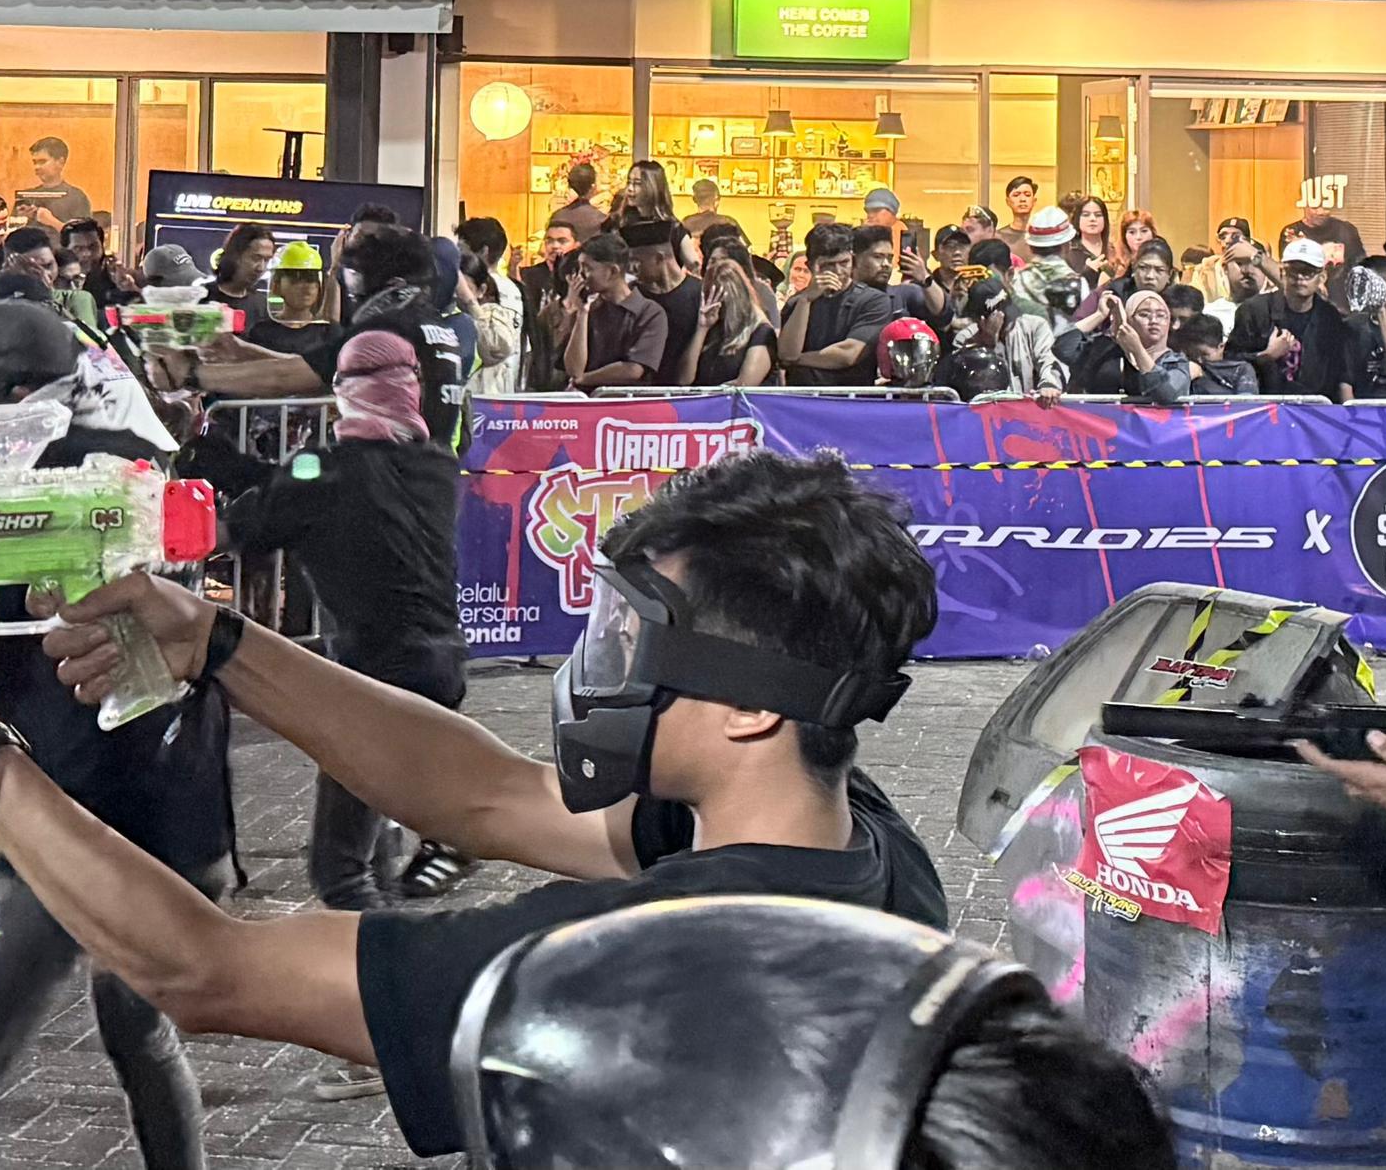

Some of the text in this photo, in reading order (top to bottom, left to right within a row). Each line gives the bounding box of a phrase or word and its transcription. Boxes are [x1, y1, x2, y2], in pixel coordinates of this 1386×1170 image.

[779, 7, 870, 23] HERE COMES
[782, 24, 868, 38] THE COFFEE
[1296, 174, 1348, 209] JUST
[176, 193, 304, 215] LIVE OPERATIONS
[486, 419, 579, 430] ASTRA MOTOR
[605, 428, 687, 474] VARIO
[457, 604, 540, 623] ersama
[458, 622, 522, 644] onda
[1095, 861, 1203, 913] HONDA
